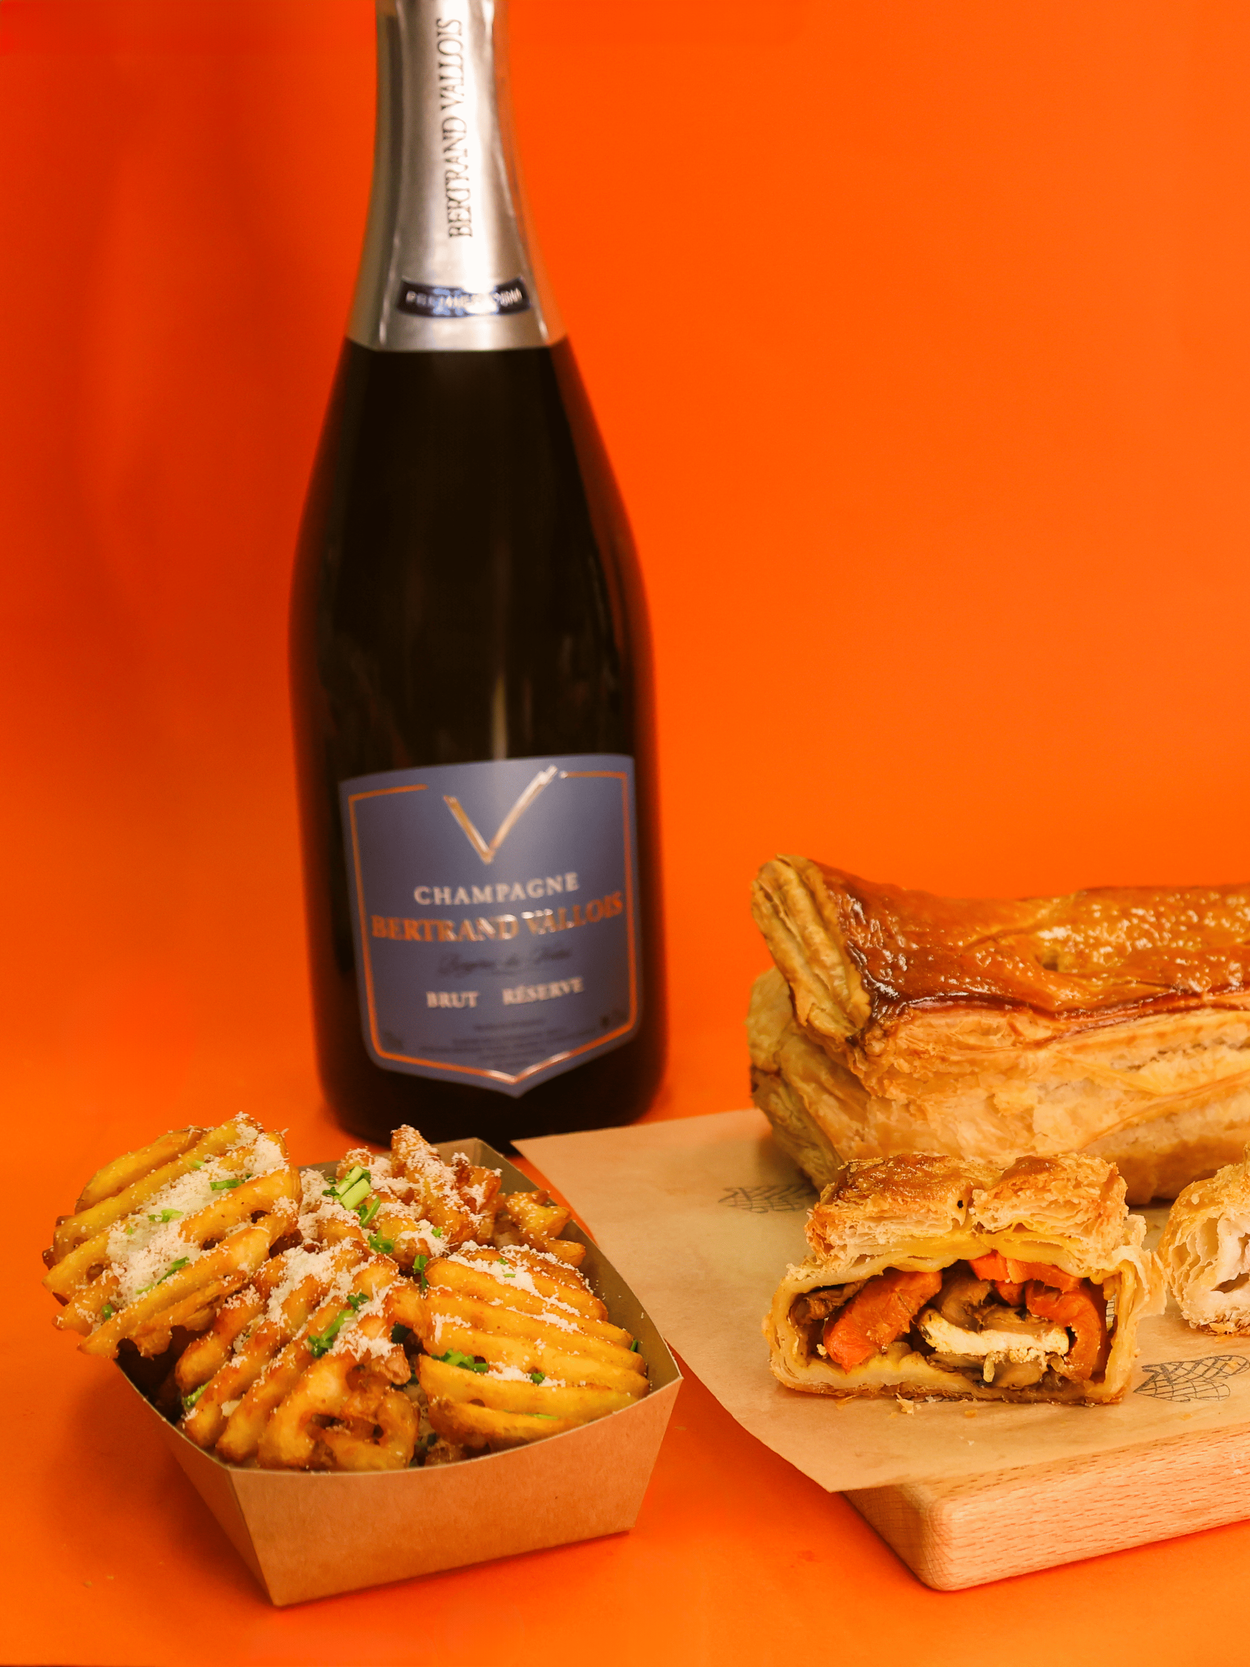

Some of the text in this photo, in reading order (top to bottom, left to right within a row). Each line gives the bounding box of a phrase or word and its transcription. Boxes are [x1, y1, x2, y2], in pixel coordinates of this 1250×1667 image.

[436, 17, 473, 238] BERTRAND VALLOIS
[413, 872, 580, 906] CHAMPAGNE
[371, 892, 624, 943] BERTRAND VALLOIS
[425, 976, 585, 1009] BRUT RÉSERVE
